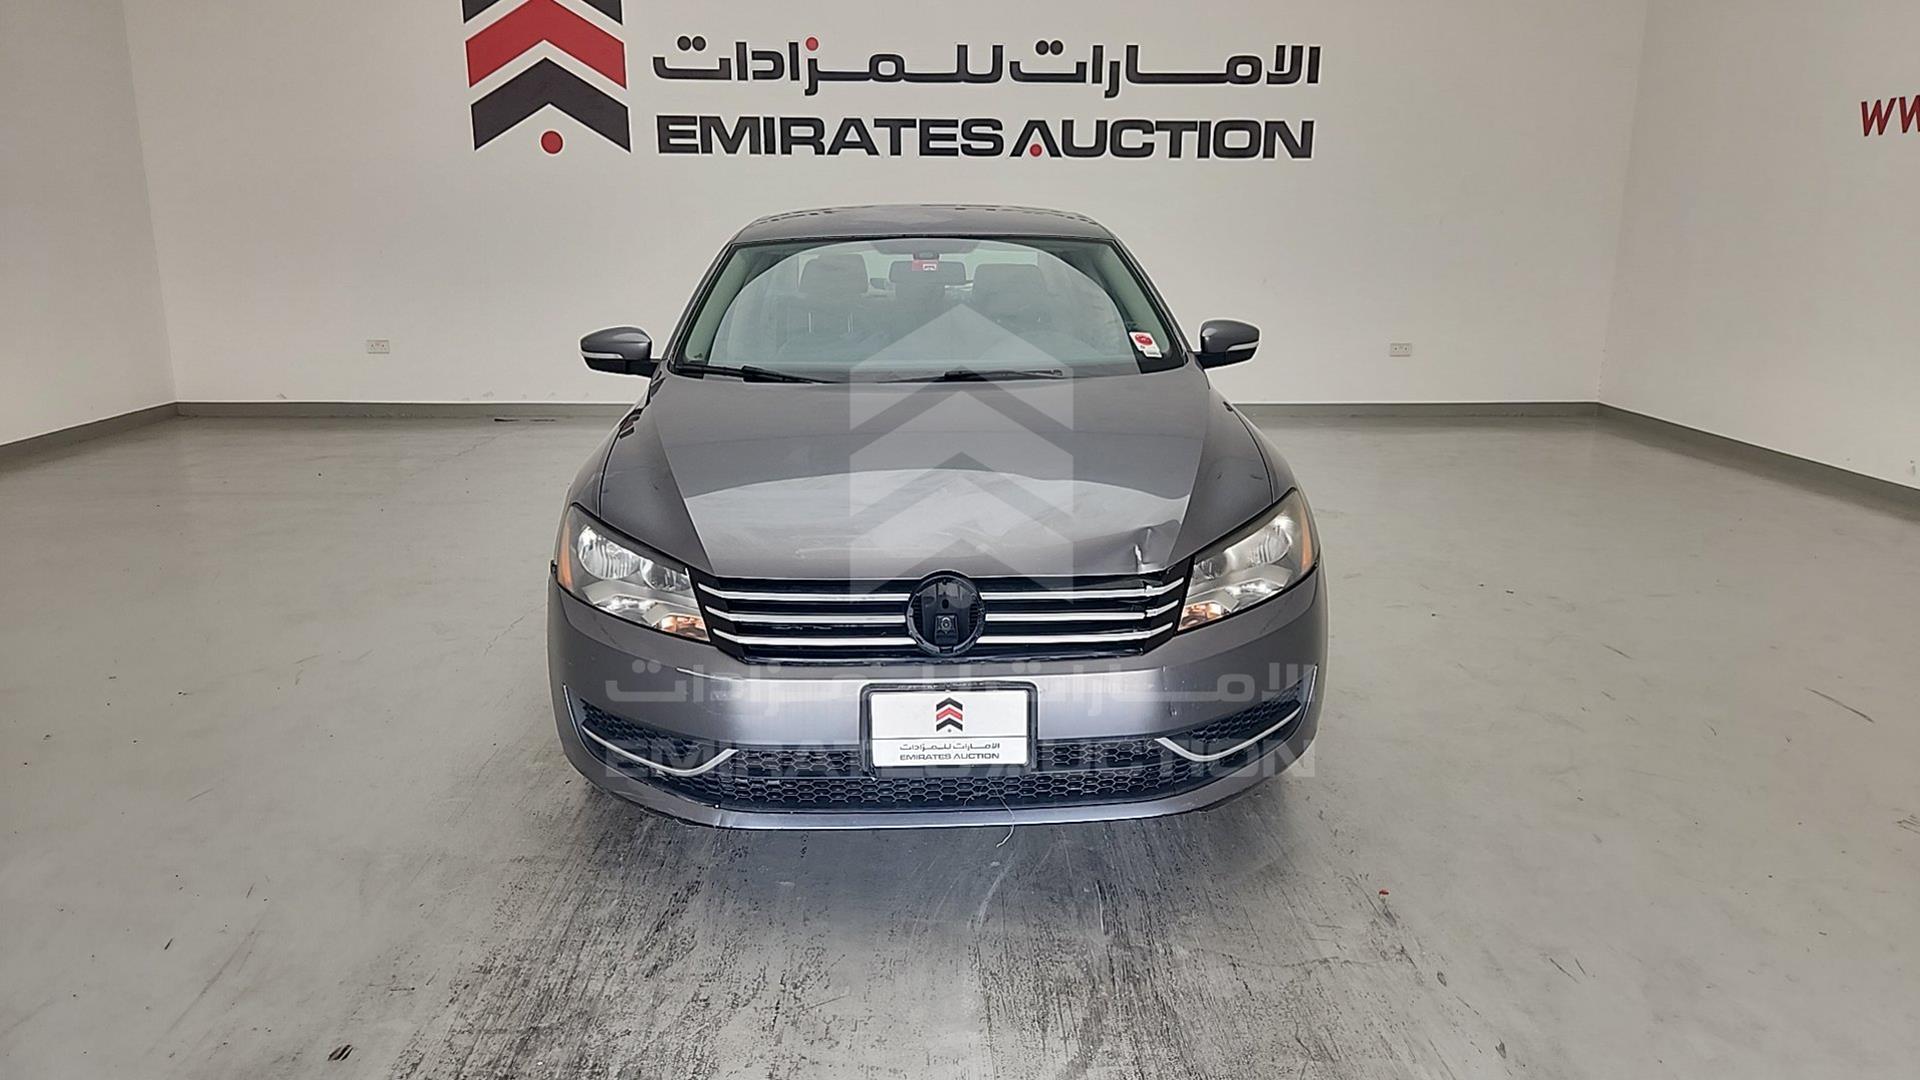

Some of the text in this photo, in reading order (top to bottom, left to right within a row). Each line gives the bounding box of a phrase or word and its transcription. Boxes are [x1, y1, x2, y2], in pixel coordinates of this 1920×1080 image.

[656, 115, 1315, 159] EMIRATES AUCTION
[900, 752, 1000, 761] EMIRATES AUCTION
